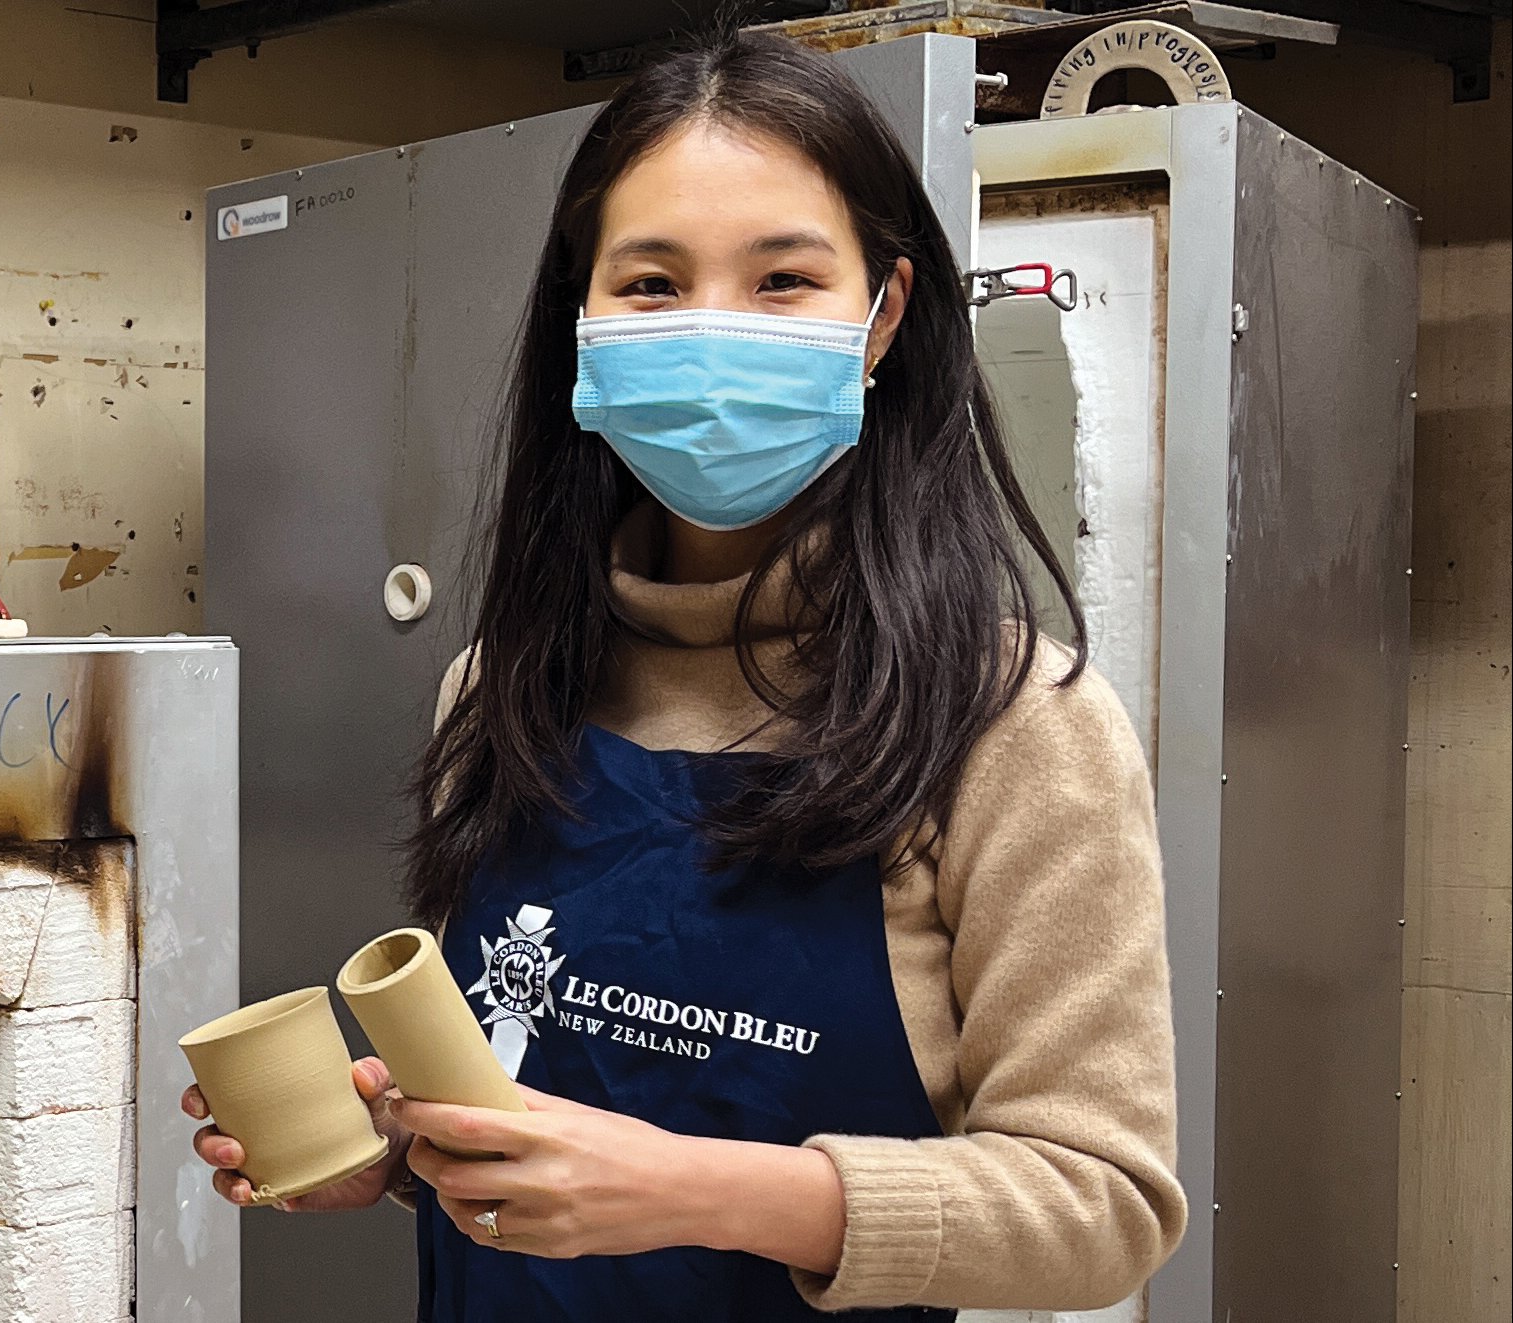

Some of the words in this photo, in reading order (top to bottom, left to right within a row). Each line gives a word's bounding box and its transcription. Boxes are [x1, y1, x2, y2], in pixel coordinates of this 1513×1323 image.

[1103, 32, 1126, 51] in
[242, 211, 282, 227] woodrow
[493, 942, 541, 965] CORDON
[490, 969, 501, 987] LE
[534, 961, 544, 998] BLEU
[500, 995, 532, 1012] PARIS
[561, 975, 600, 1007] LE
[600, 985, 728, 1036] CORDON
[730, 1011, 820, 1054] BLEU
[559, 1010, 605, 1036] NEW
[611, 1024, 711, 1060] ZEALAND
